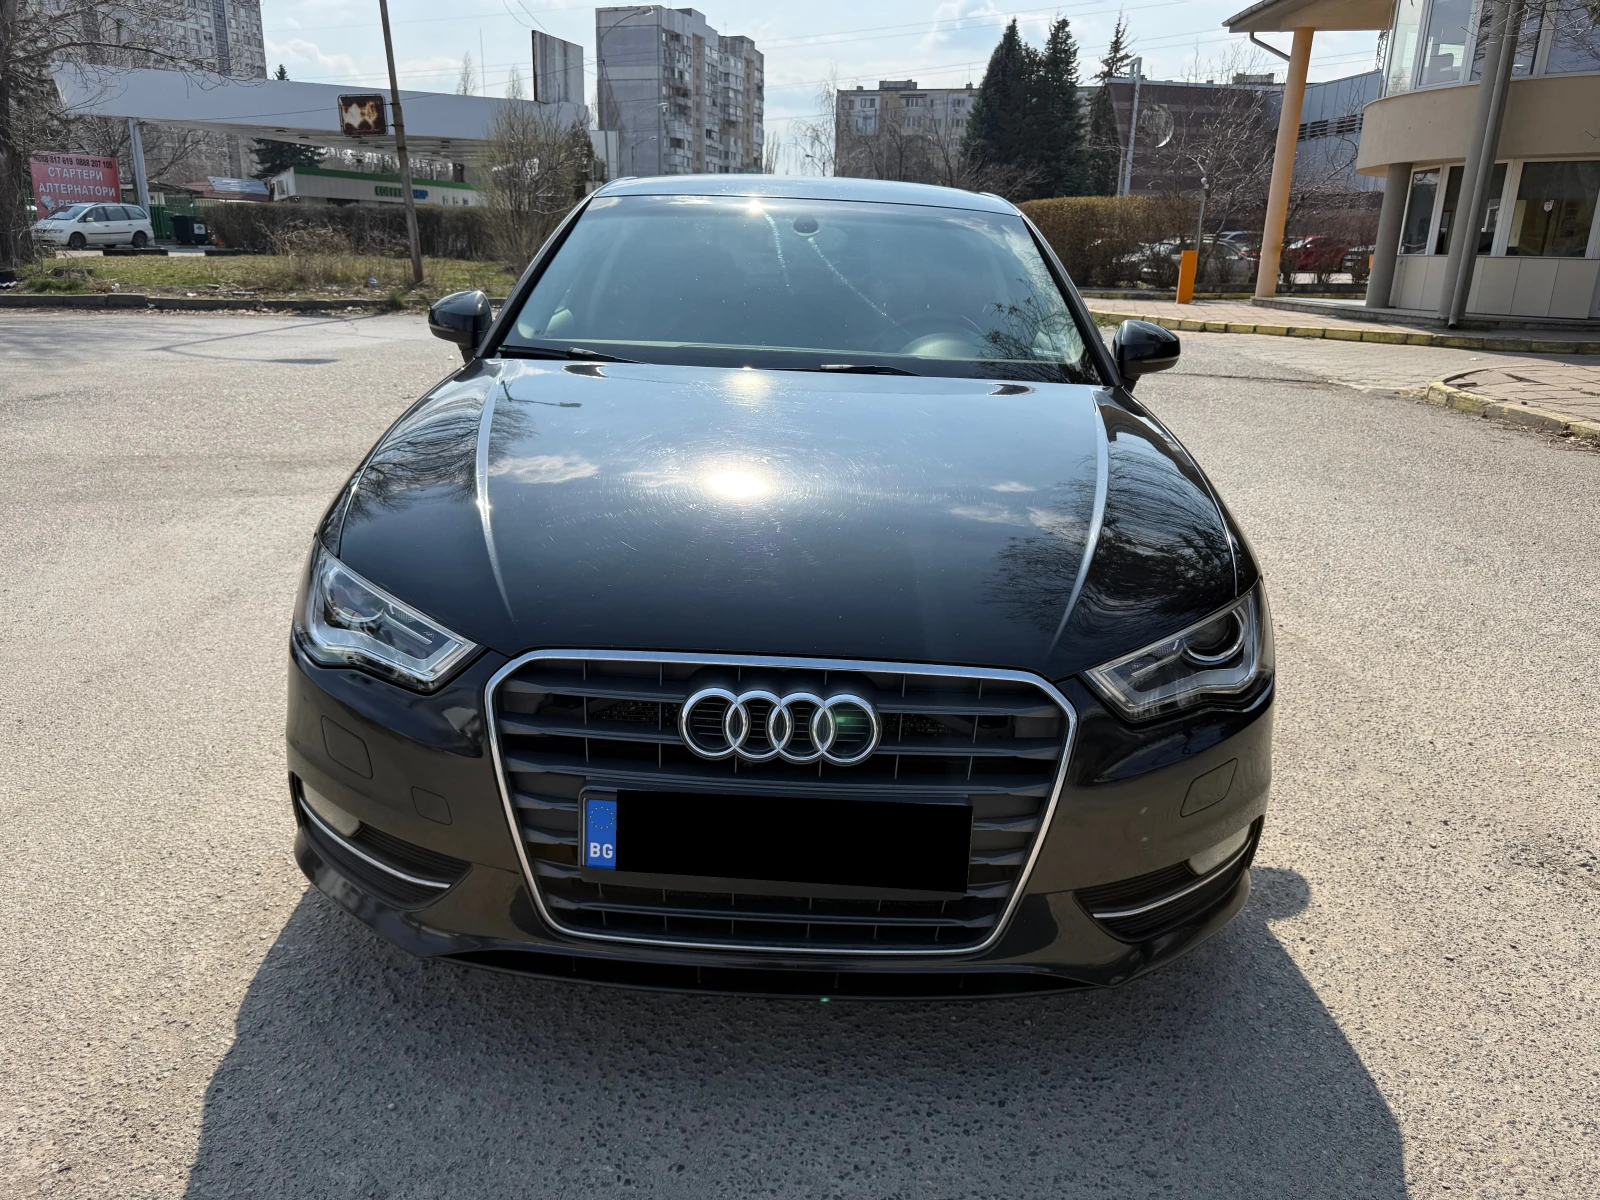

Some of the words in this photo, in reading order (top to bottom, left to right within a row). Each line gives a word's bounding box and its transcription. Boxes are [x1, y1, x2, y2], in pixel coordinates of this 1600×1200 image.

[62, 157, 73, 165] 619
[76, 158, 90, 167] 0888
[91, 159, 101, 168] 207
[103, 161, 113, 169] 105
[48, 167, 103, 180] СТАРТЕРИ
[39, 183, 116, 197] АЛТЕРНАТОРИ
[590, 842, 613, 859] BG
